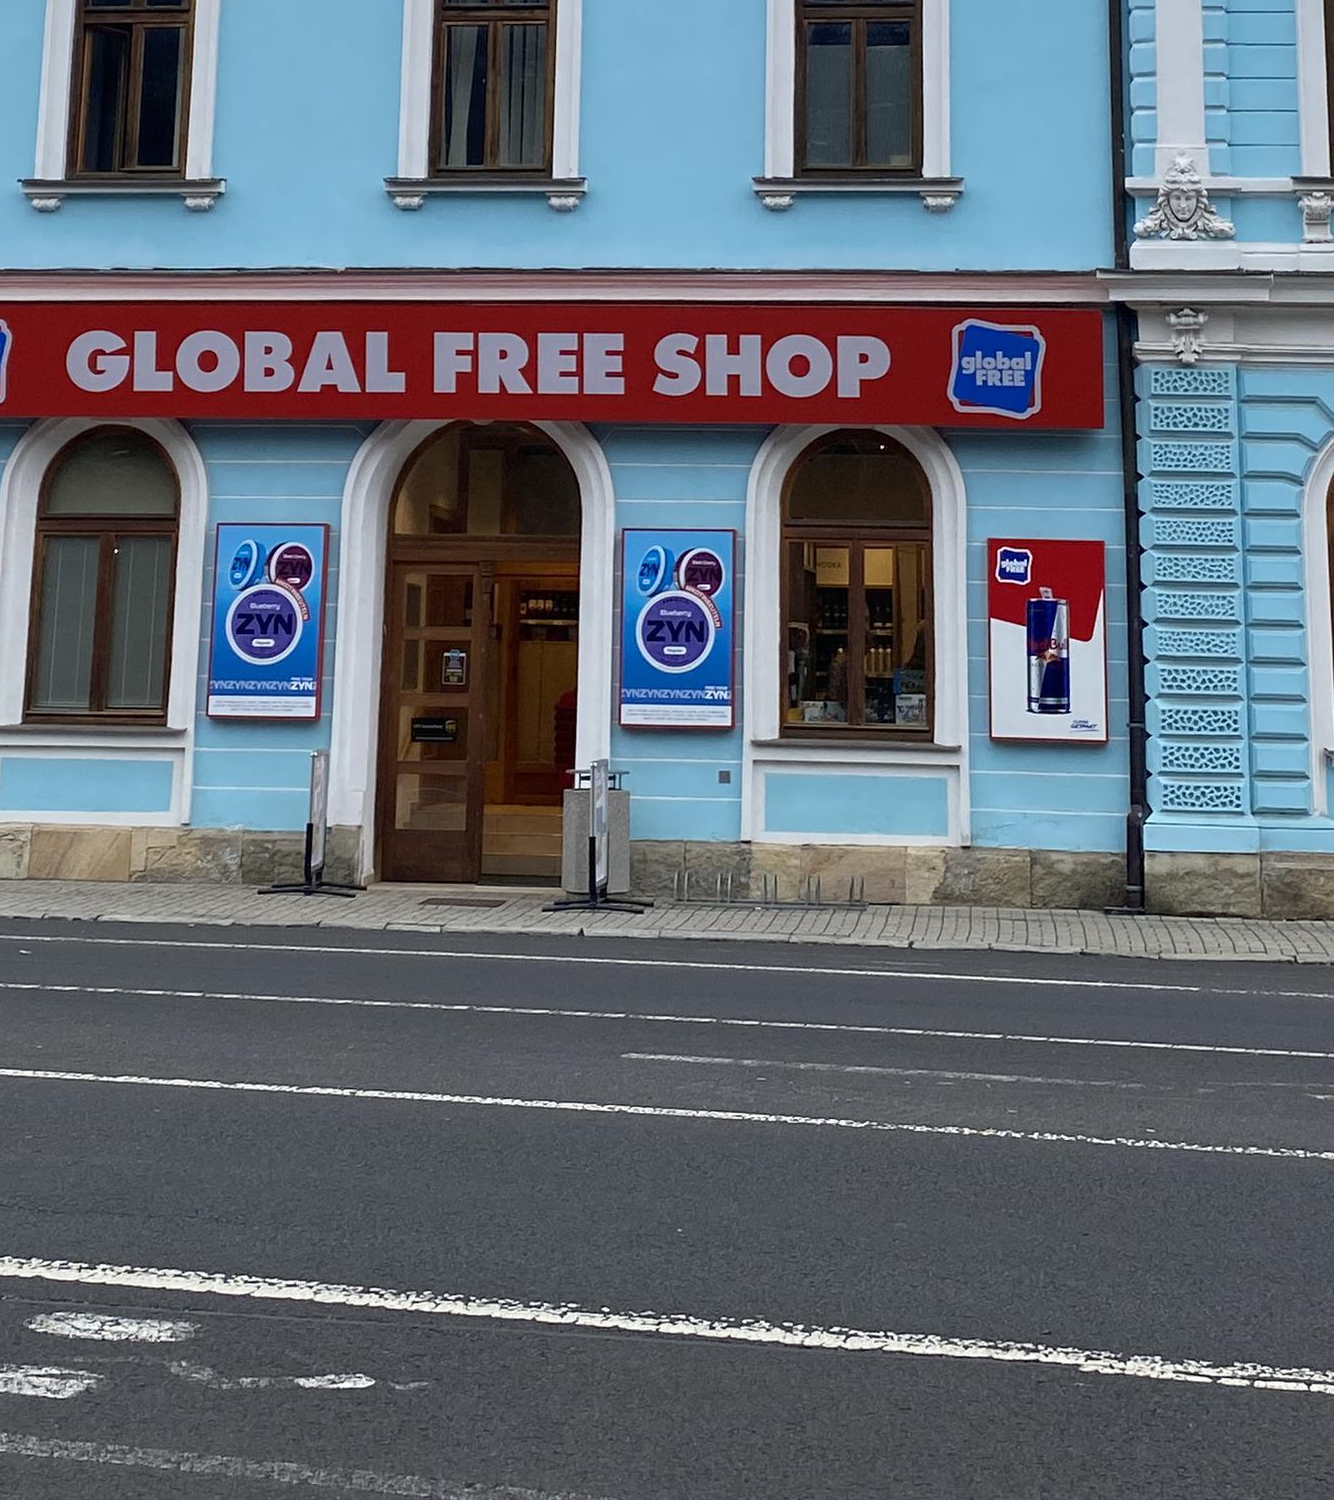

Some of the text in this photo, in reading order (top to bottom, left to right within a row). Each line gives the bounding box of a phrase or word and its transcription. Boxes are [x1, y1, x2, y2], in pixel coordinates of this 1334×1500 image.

[66, 329, 891, 399] GLOBAL FREE SHOP
[961, 350, 1032, 374] global
[975, 369, 1026, 387] FREE
[236, 613, 293, 636] ZYN
[647, 620, 705, 643] ZYN
